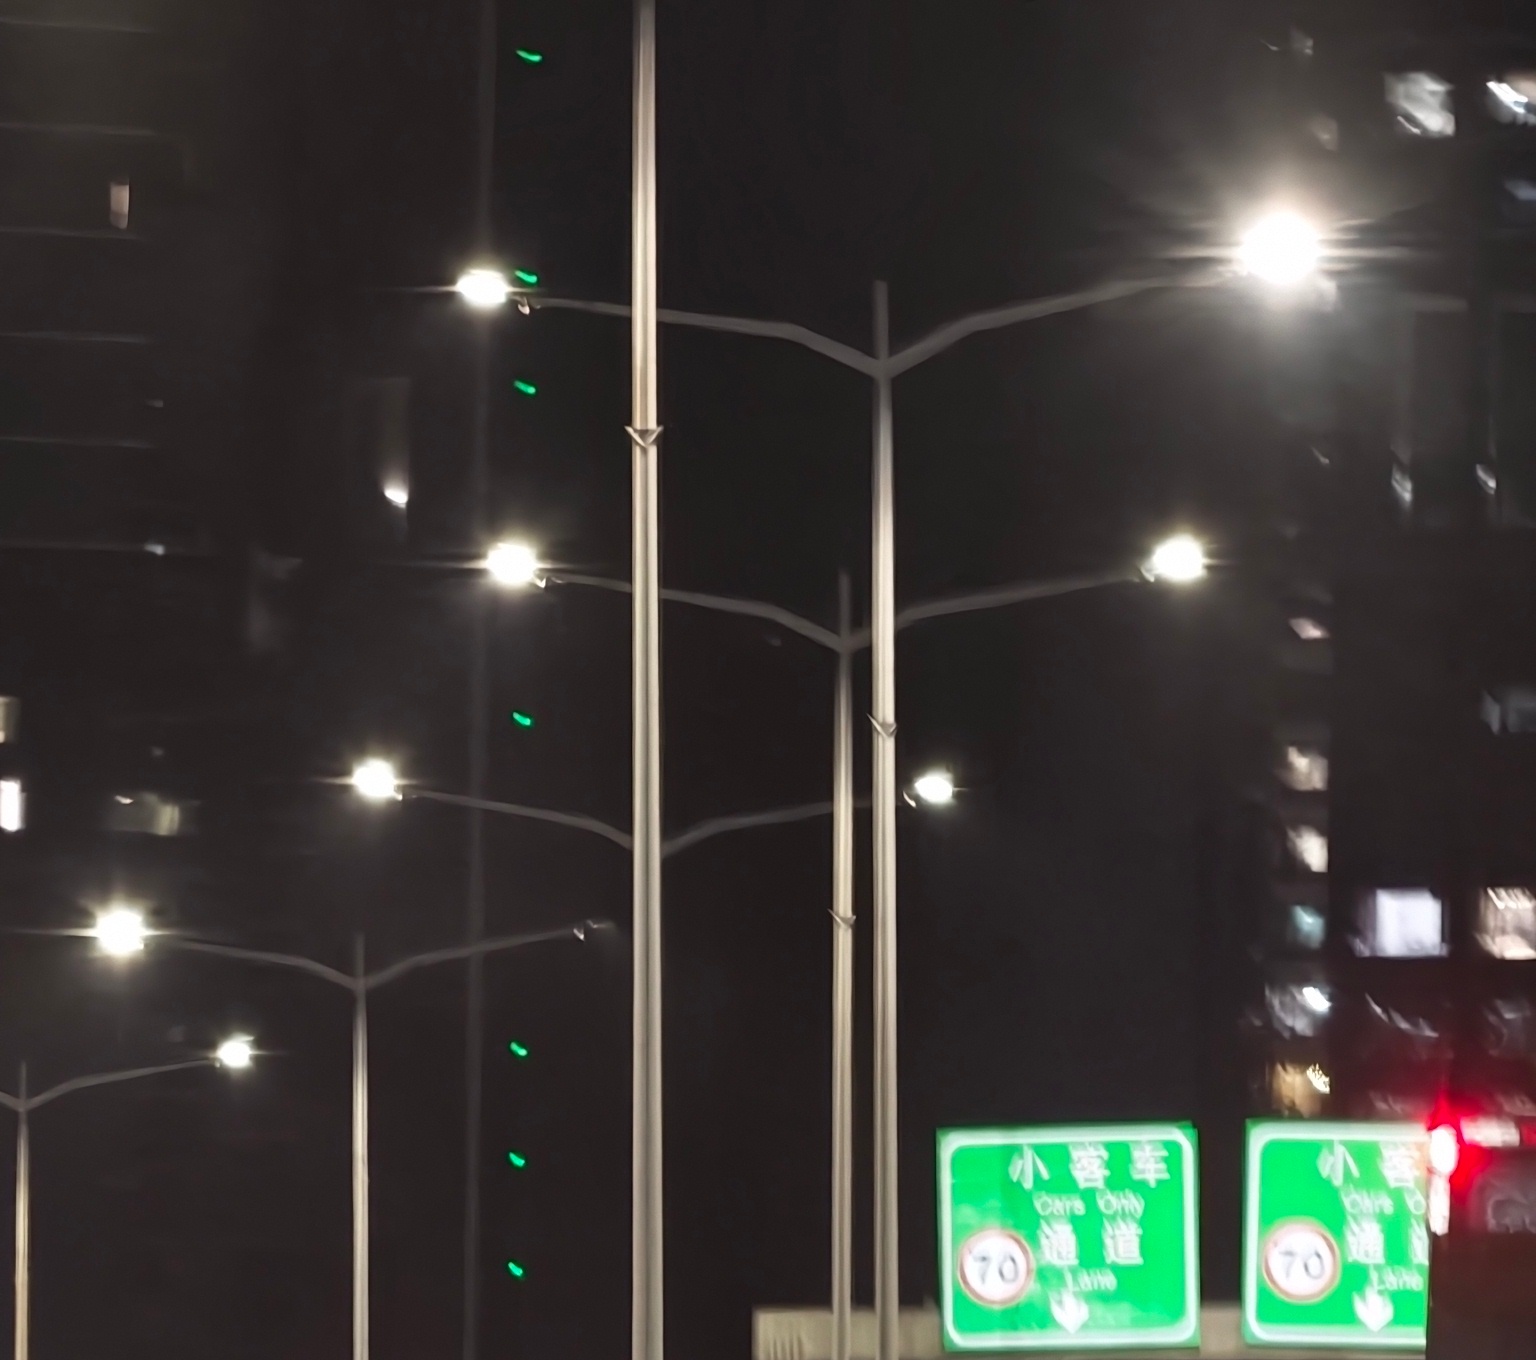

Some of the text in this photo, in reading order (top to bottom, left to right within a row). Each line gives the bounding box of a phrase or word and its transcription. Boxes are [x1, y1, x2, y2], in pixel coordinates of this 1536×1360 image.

[1008, 1141, 1171, 1189] 小客车
[1037, 1218, 1145, 1266] 通道
[972, 1252, 1020, 1285] 70
[1279, 1247, 1325, 1280] 70
